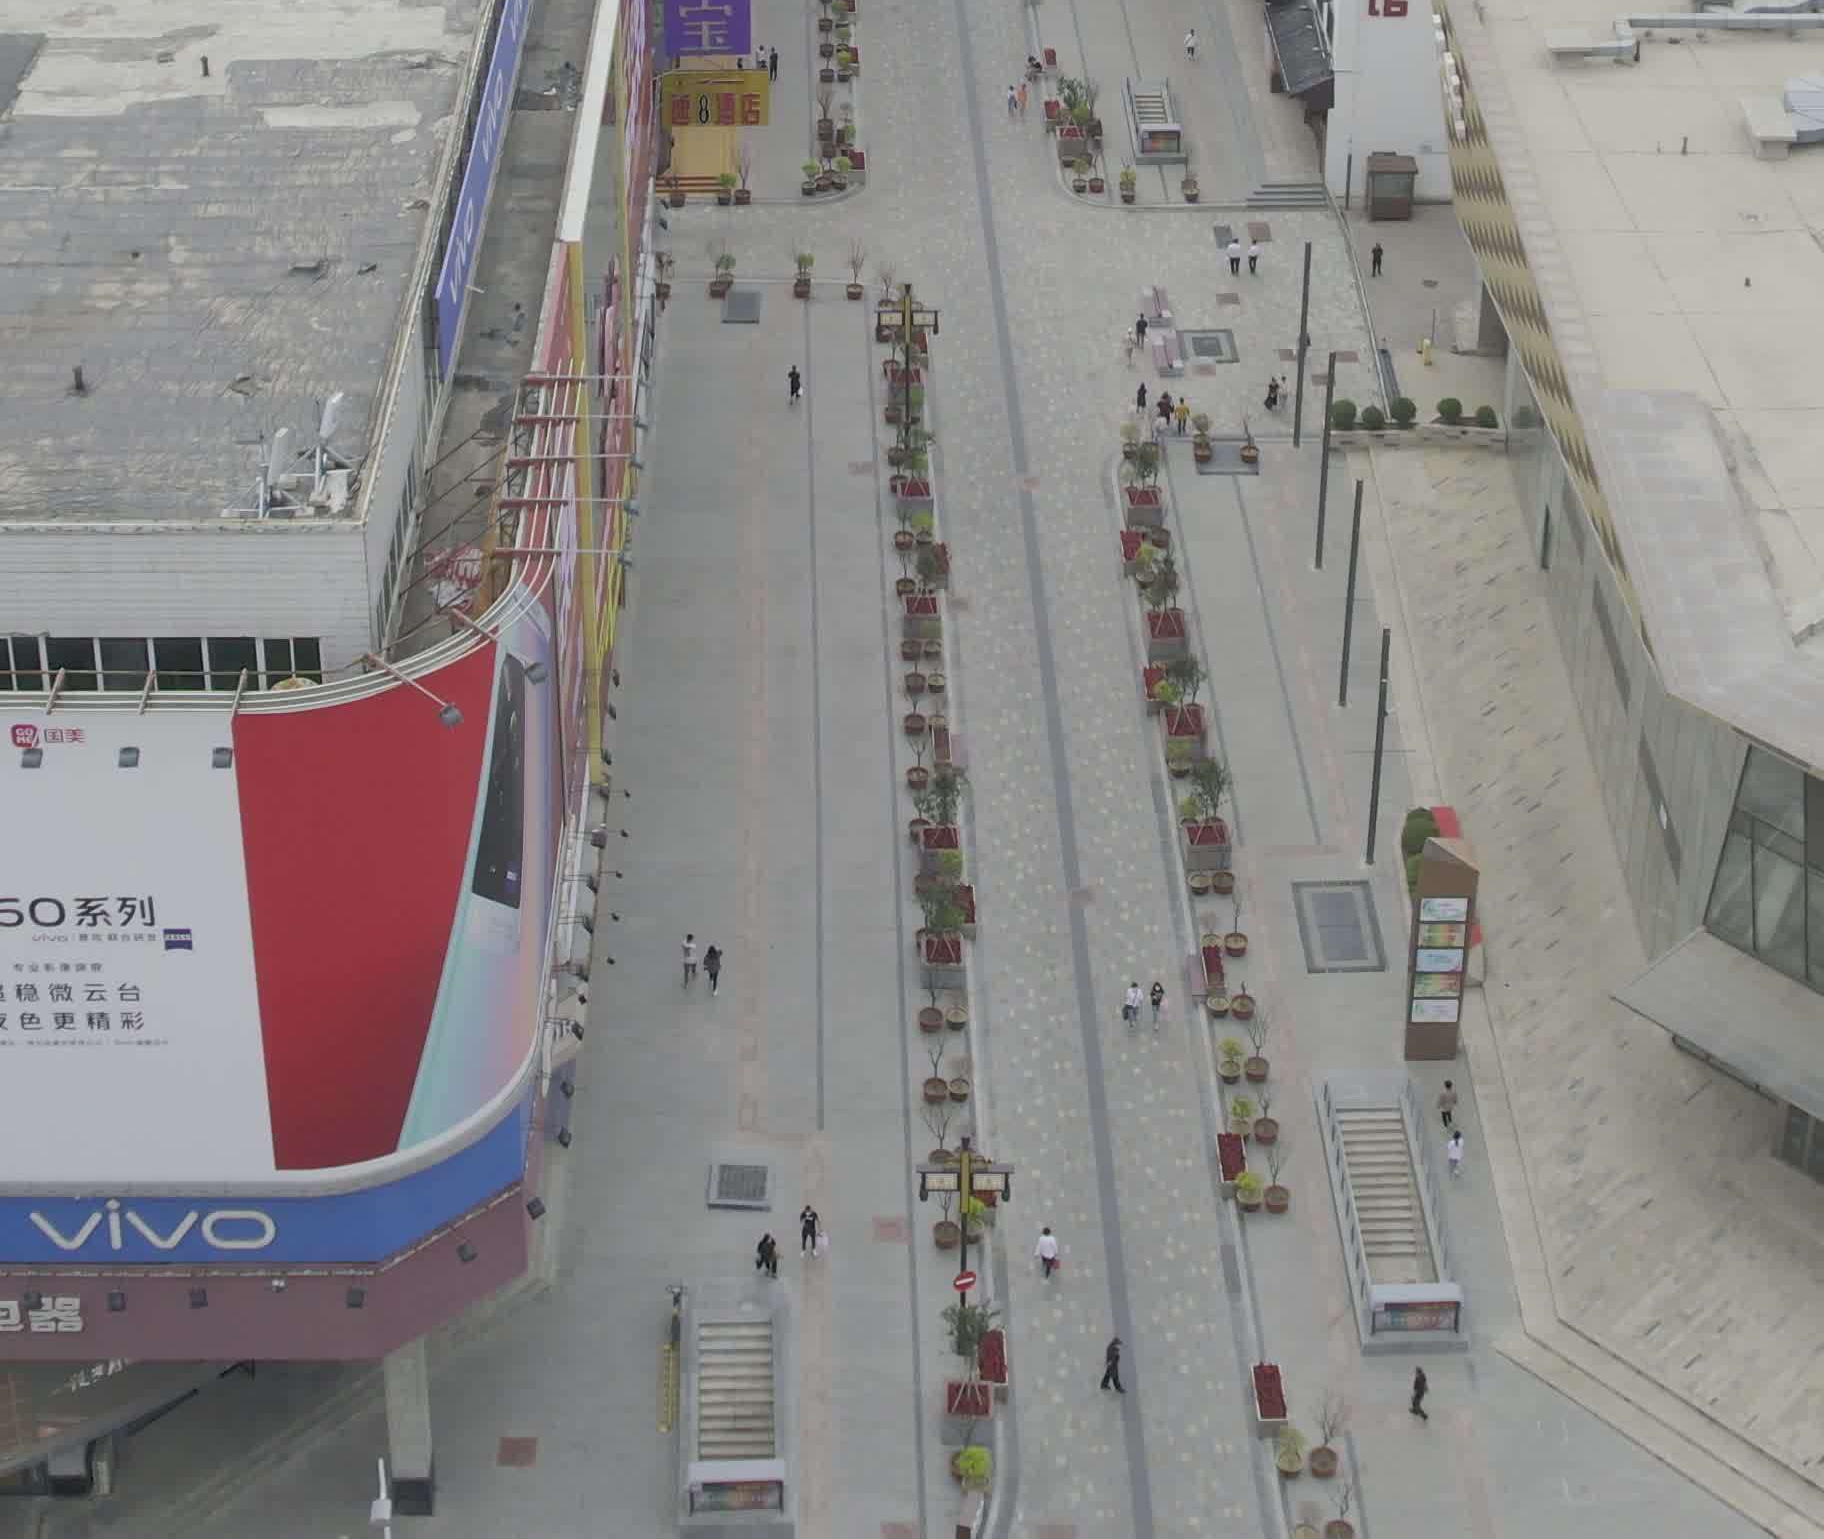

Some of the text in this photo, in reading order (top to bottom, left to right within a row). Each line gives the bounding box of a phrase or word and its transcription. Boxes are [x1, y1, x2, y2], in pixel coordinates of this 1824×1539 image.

[482, 68, 503, 163] vivo
[450, 197, 474, 305] vivo
[44, 728, 85, 743] 国美
[28, 1198, 277, 1251] vivo
